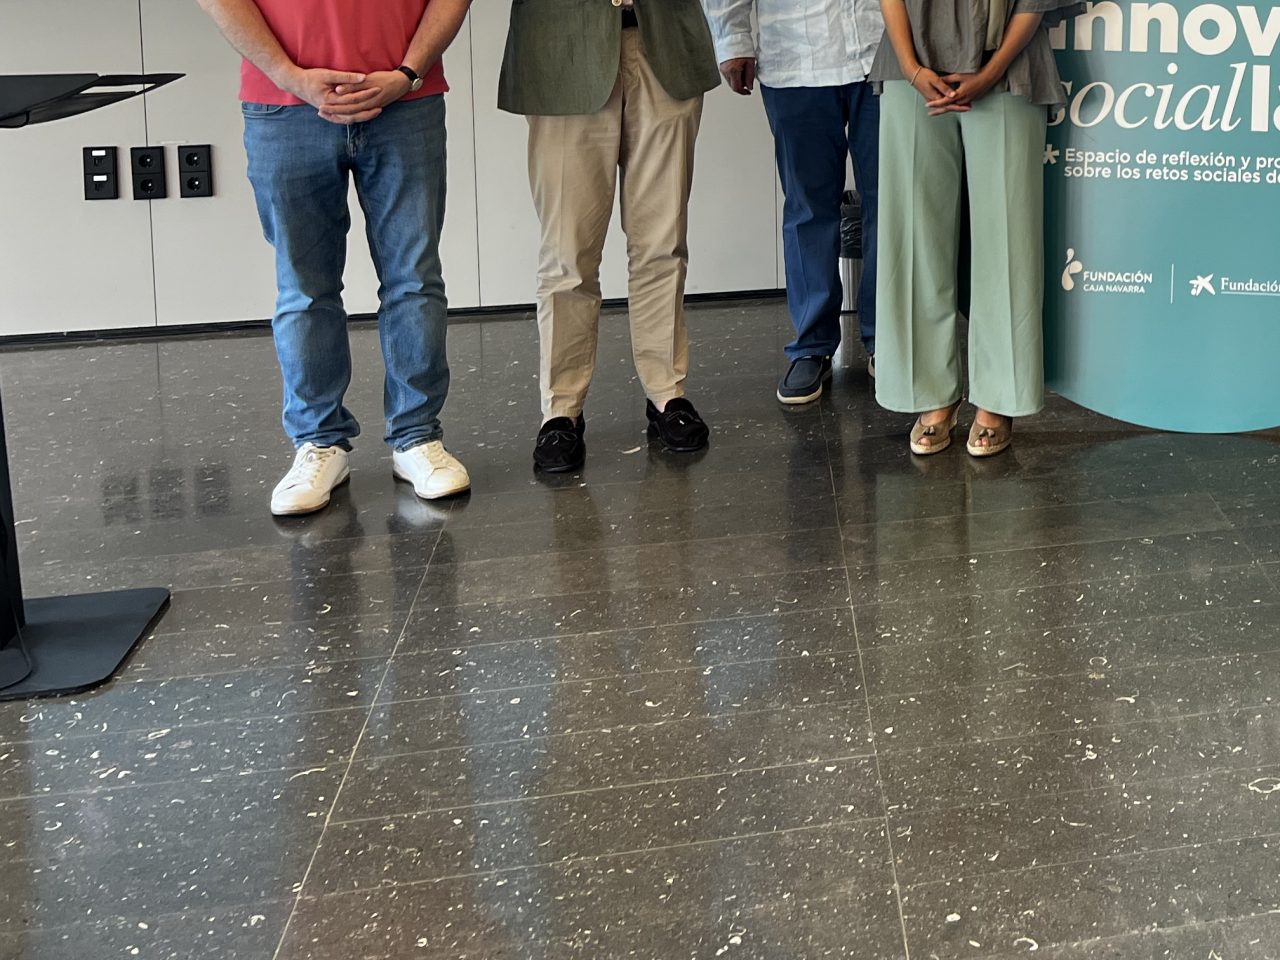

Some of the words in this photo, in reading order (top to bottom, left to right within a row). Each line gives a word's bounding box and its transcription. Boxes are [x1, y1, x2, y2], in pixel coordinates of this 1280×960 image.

[1065, 148, 1131, 167] Espacio
[1136, 149, 1158, 164] de
[1162, 150, 1236, 167] reflexión
[1240, 155, 1252, 170] y
[1064, 164, 1112, 178] sobre
[1117, 164, 1141, 179] los
[1145, 167, 1189, 181] retos
[1193, 168, 1261, 183] sociales
[1083, 270, 1153, 283] FUNDACIÓN
[1083, 284, 1105, 292] CAJA
[1105, 284, 1145, 294] NAVARRA
